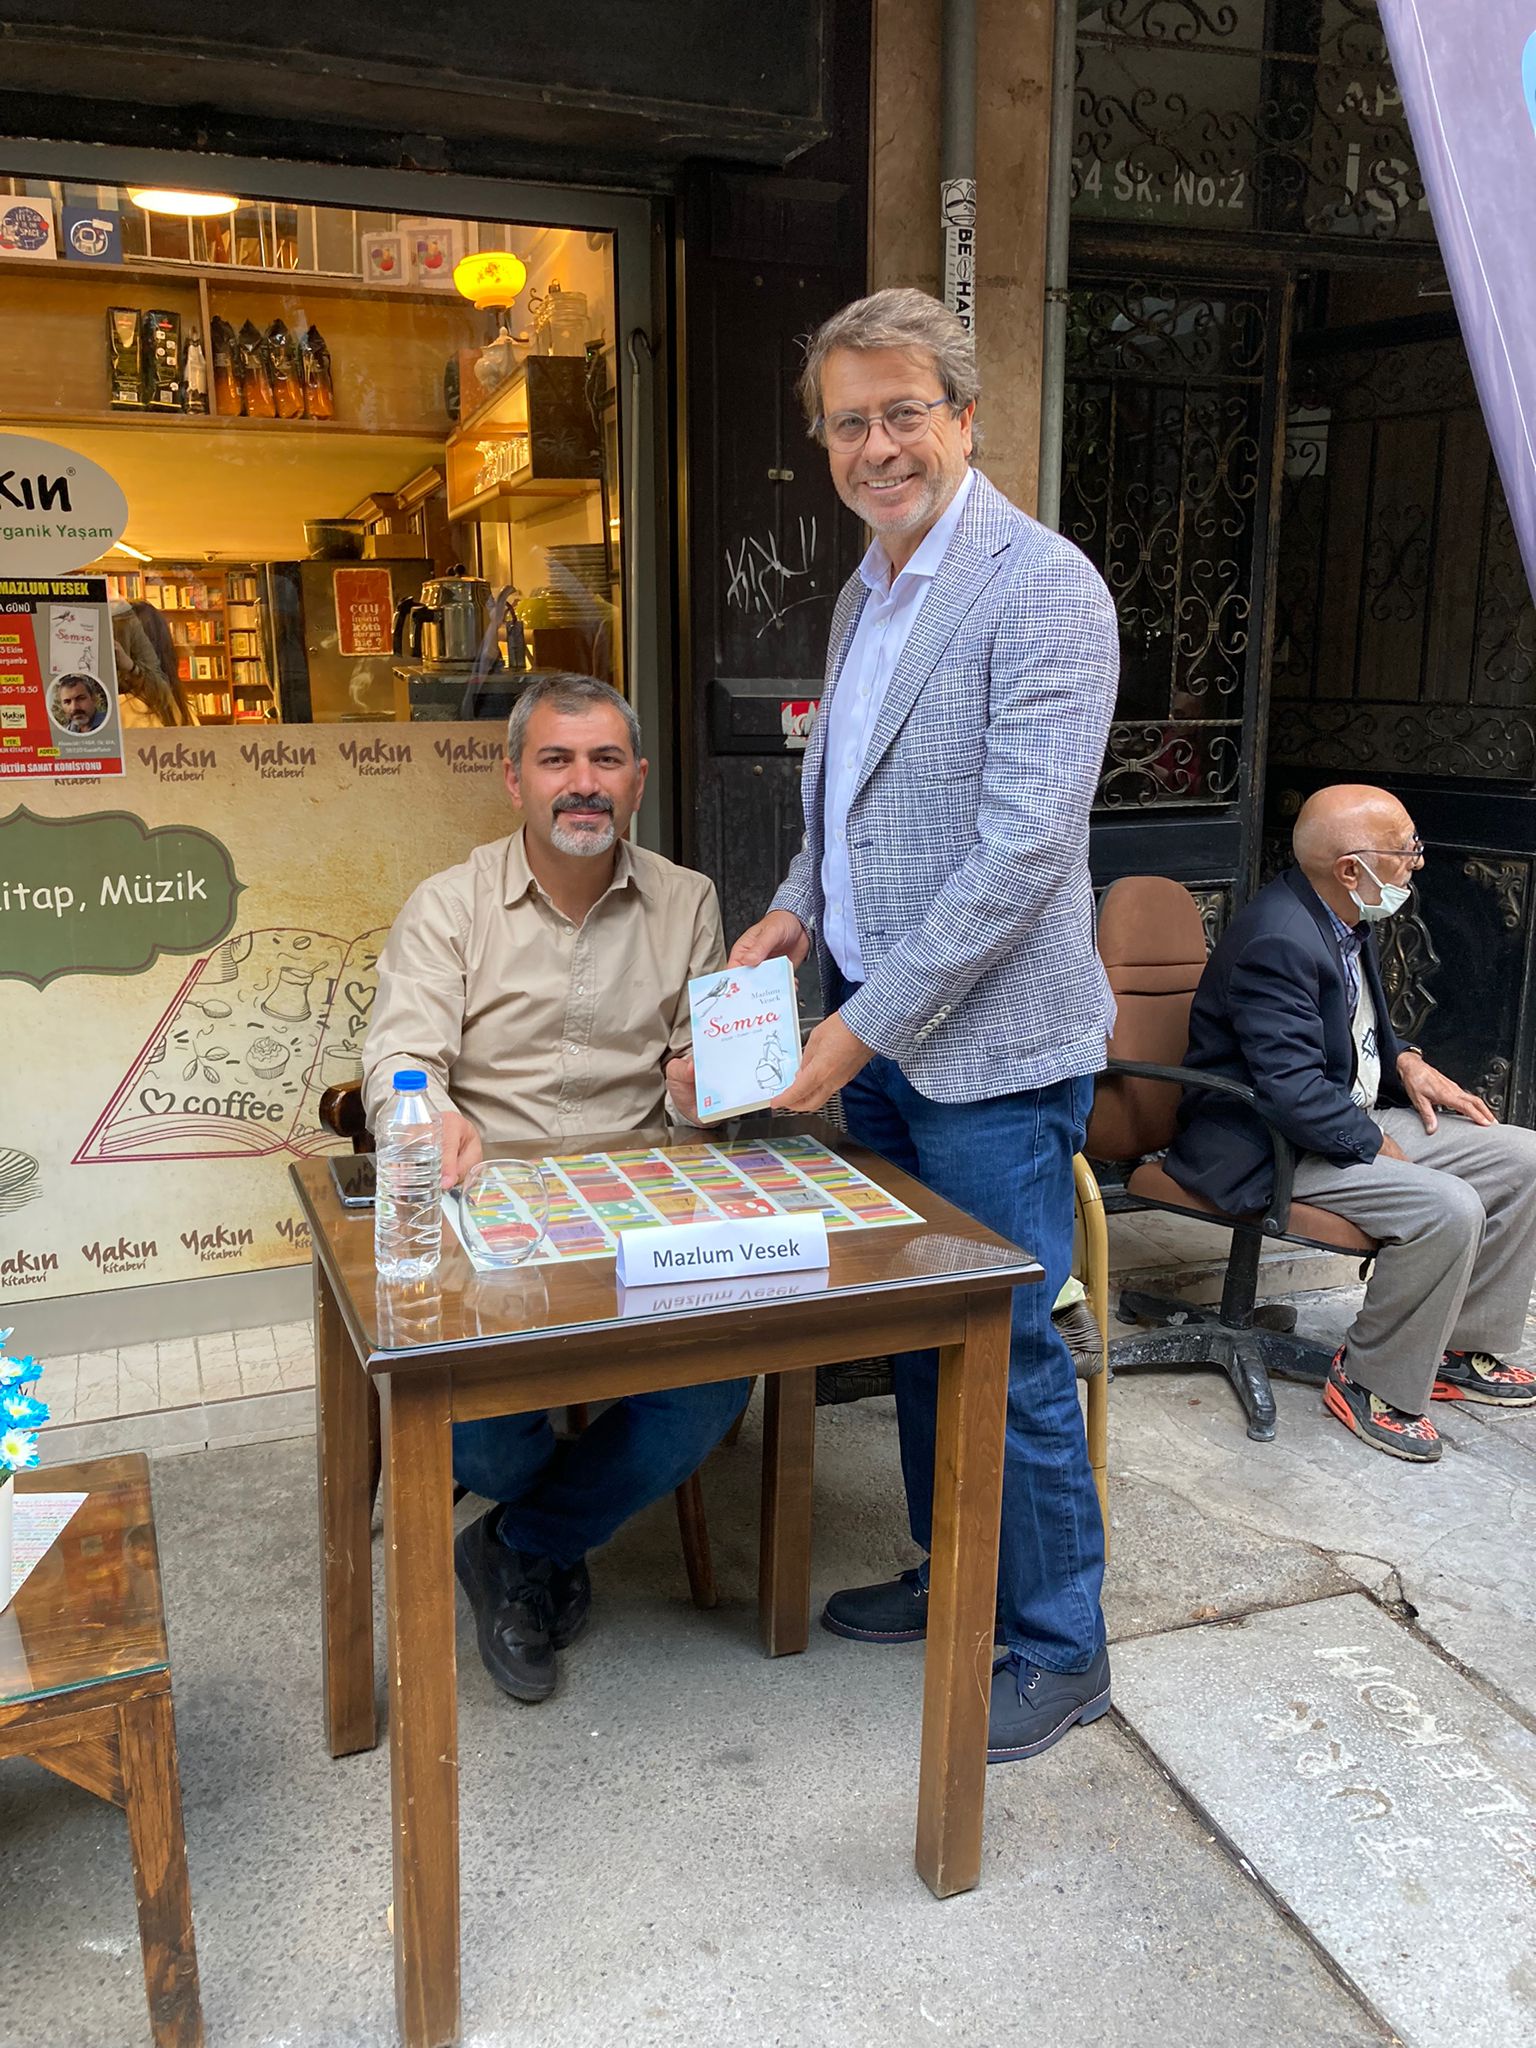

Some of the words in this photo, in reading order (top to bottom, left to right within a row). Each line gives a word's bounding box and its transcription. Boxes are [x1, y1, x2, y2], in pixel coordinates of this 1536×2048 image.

[1174, 164, 1244, 209] No:2
[957, 228, 973, 256] BE
[955, 281, 971, 339] HAP
[56, 524, 113, 541] Yaşam
[50, 582, 90, 596] VESEK
[27, 762, 53, 773] SANAT
[54, 760, 102, 772] KOMİSYONU
[0, 880, 86, 918] itap,
[100, 870, 208, 906] Müzik
[704, 1011, 781, 1038] Semra
[182, 1089, 285, 1123] coffee
[653, 1246, 734, 1268] Mazlum
[739, 1238, 800, 1261] Vesek
